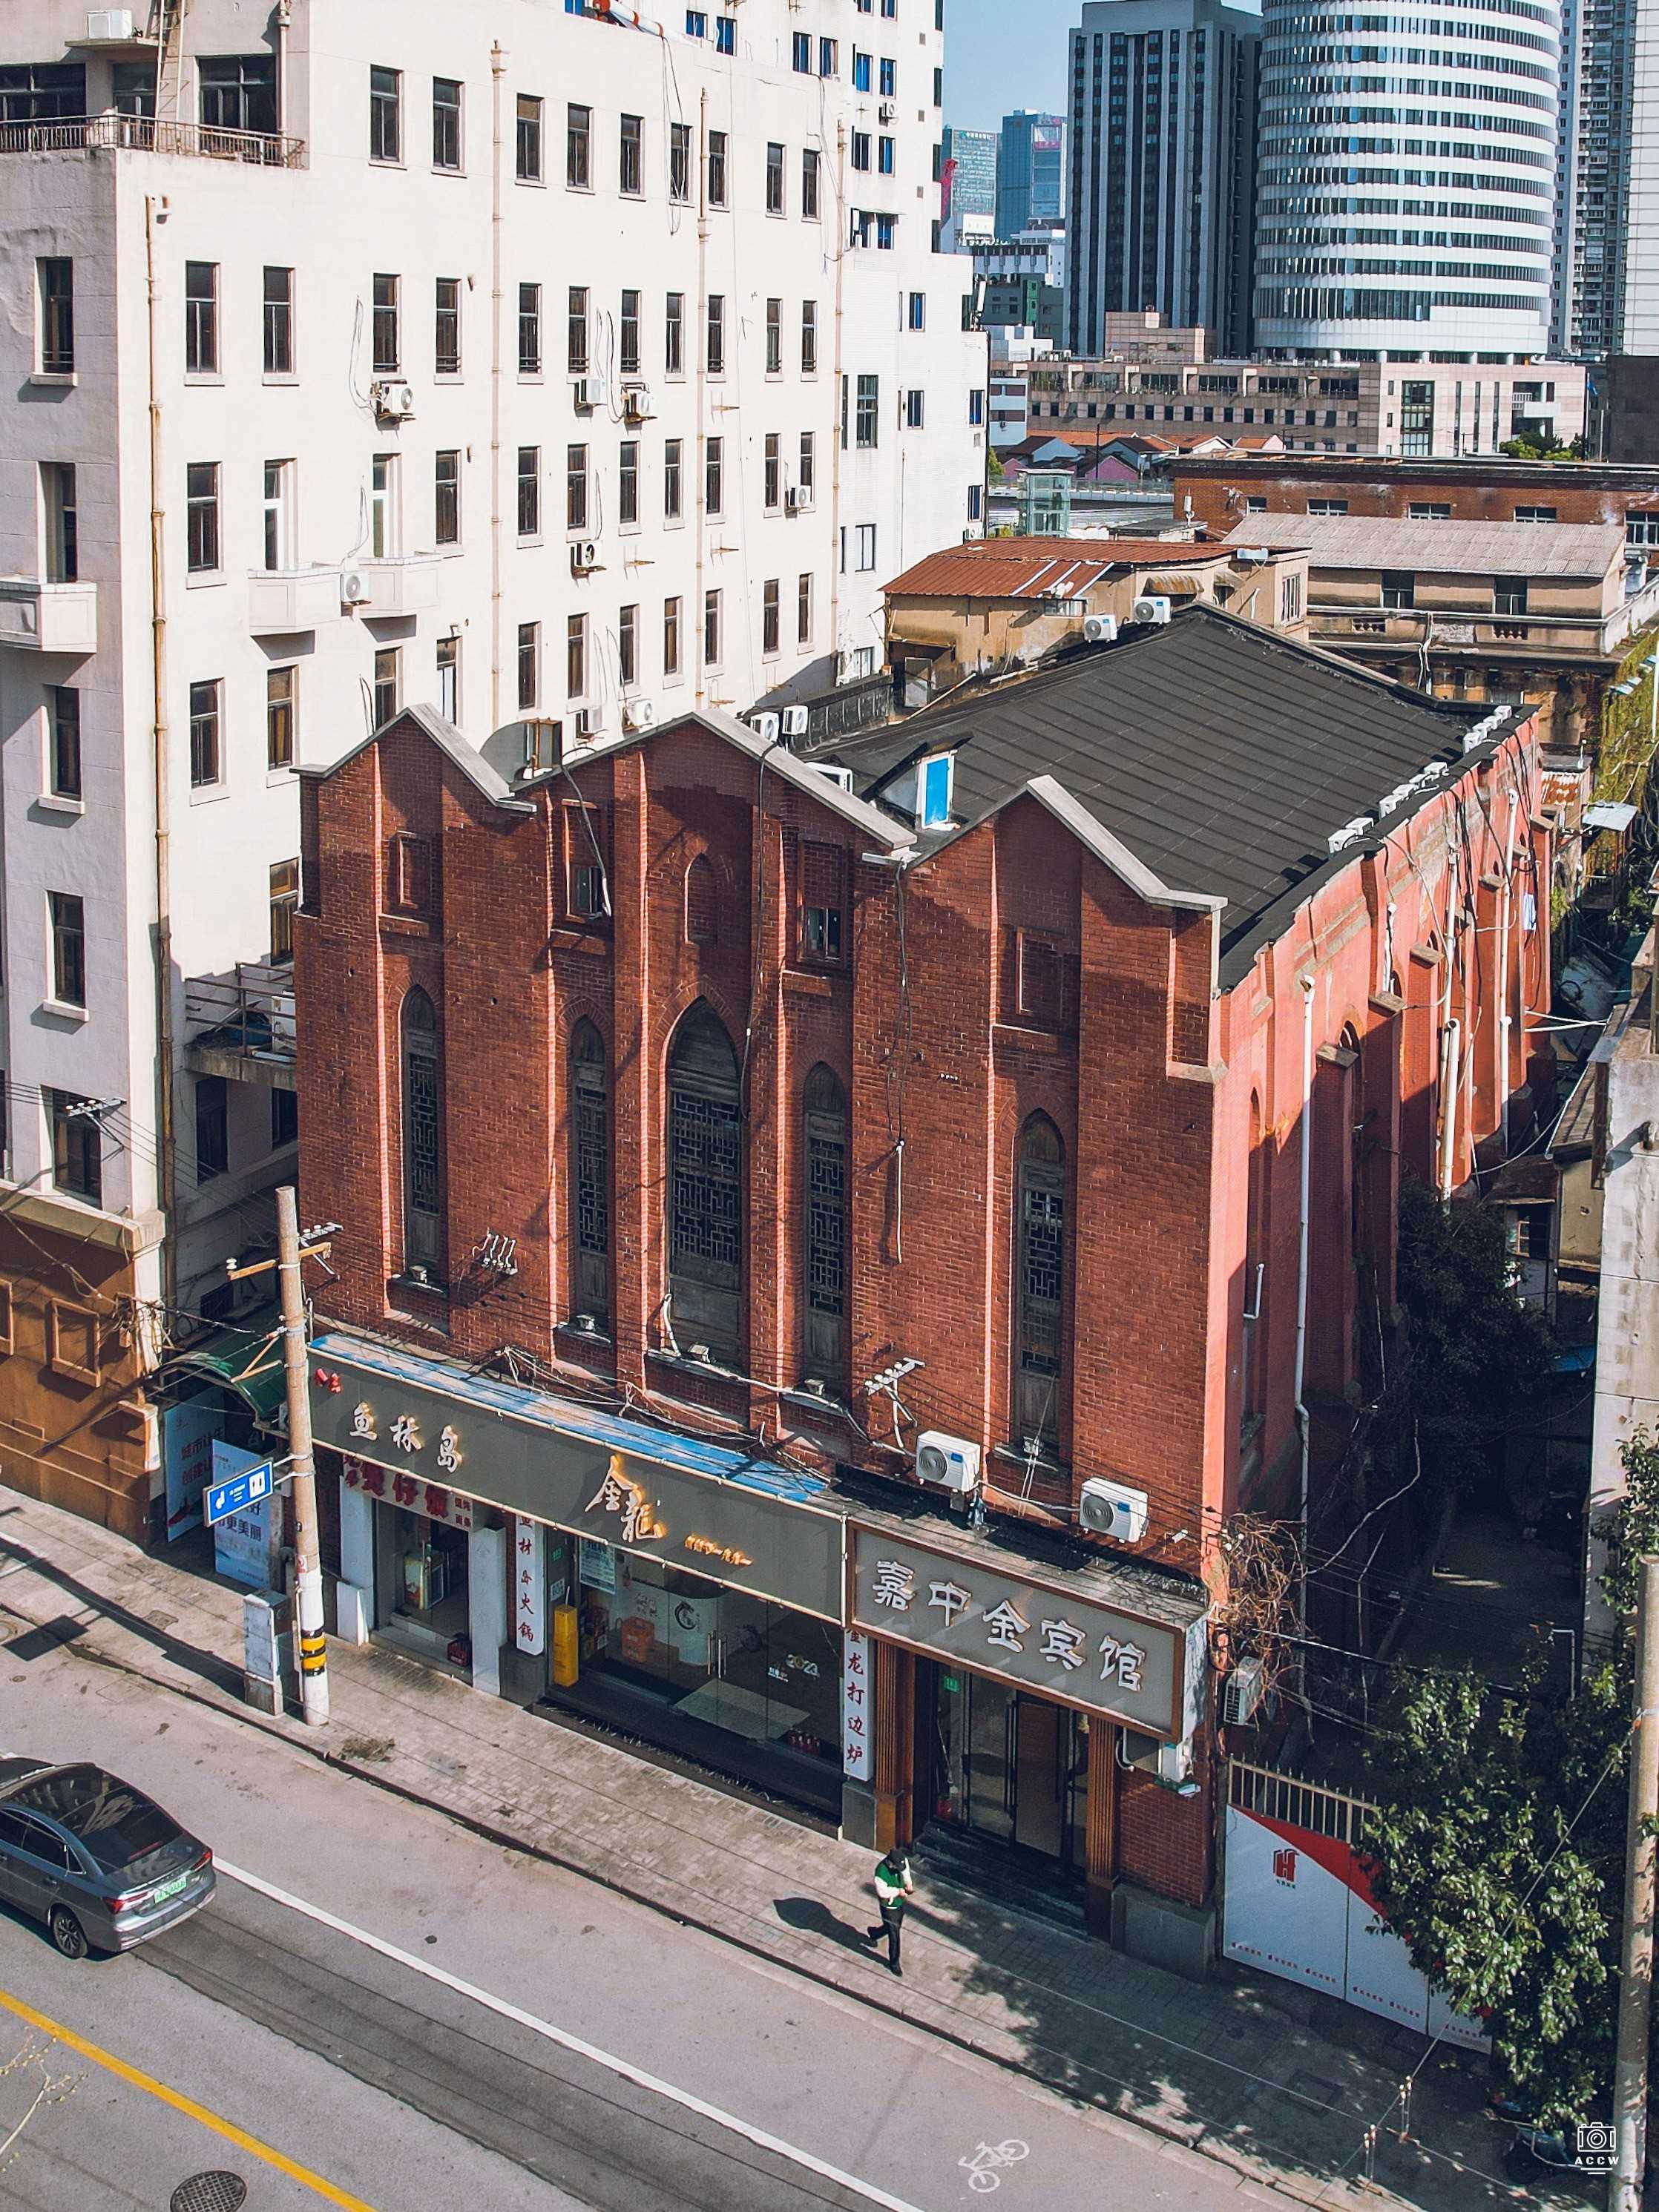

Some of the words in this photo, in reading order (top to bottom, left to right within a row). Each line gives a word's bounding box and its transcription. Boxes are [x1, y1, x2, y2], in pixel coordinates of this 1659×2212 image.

[349, 1401, 462, 1473] 鱼林岛
[872, 1560, 1146, 1692] 嘉中金宾馆
